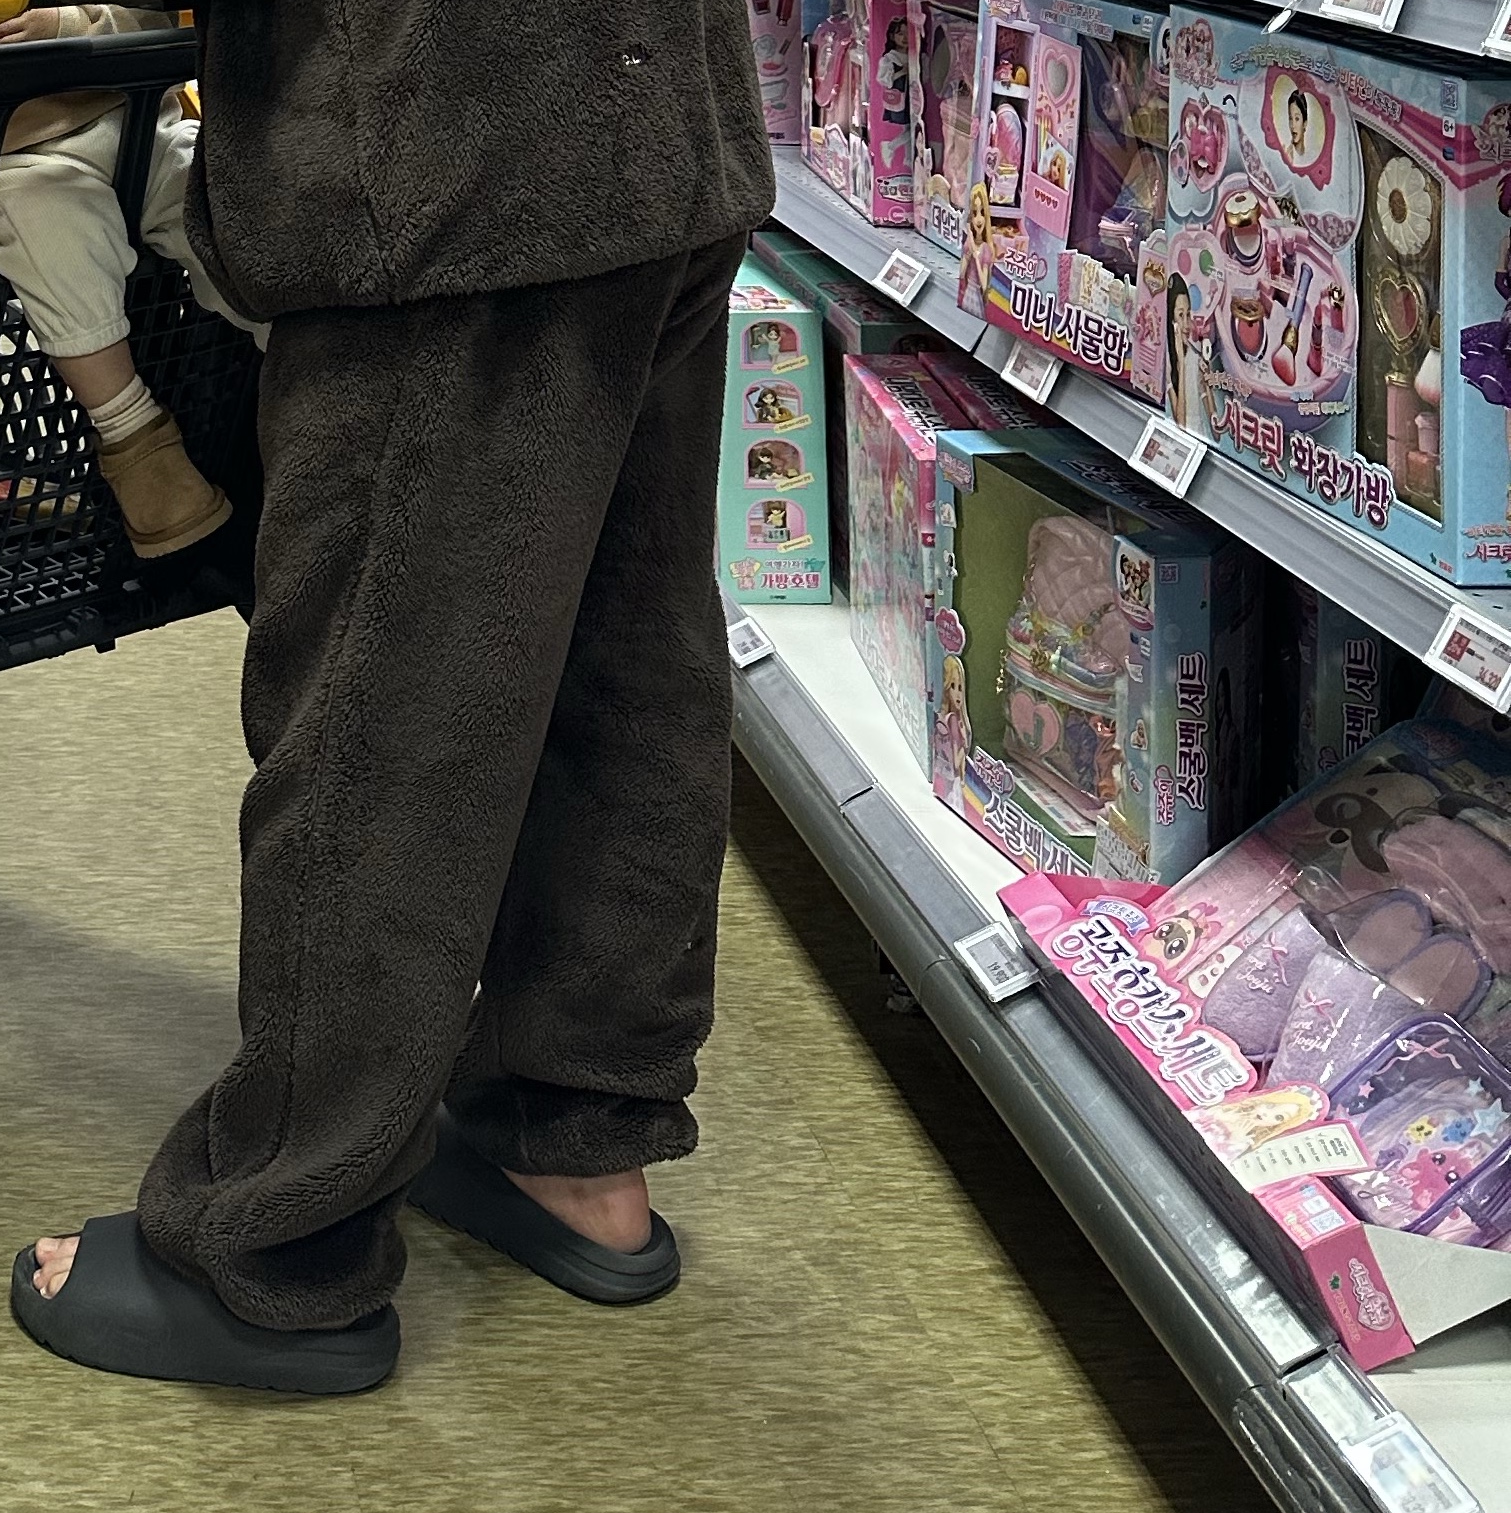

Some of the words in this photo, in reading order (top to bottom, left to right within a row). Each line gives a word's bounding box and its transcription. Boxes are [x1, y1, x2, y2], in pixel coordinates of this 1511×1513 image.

[1009, 281, 1055, 342] 미니
[1055, 300, 1131, 377] 사물함
[1212, 397, 1288, 479] 시크릿
[1289, 428, 1396, 530] 화장가방
